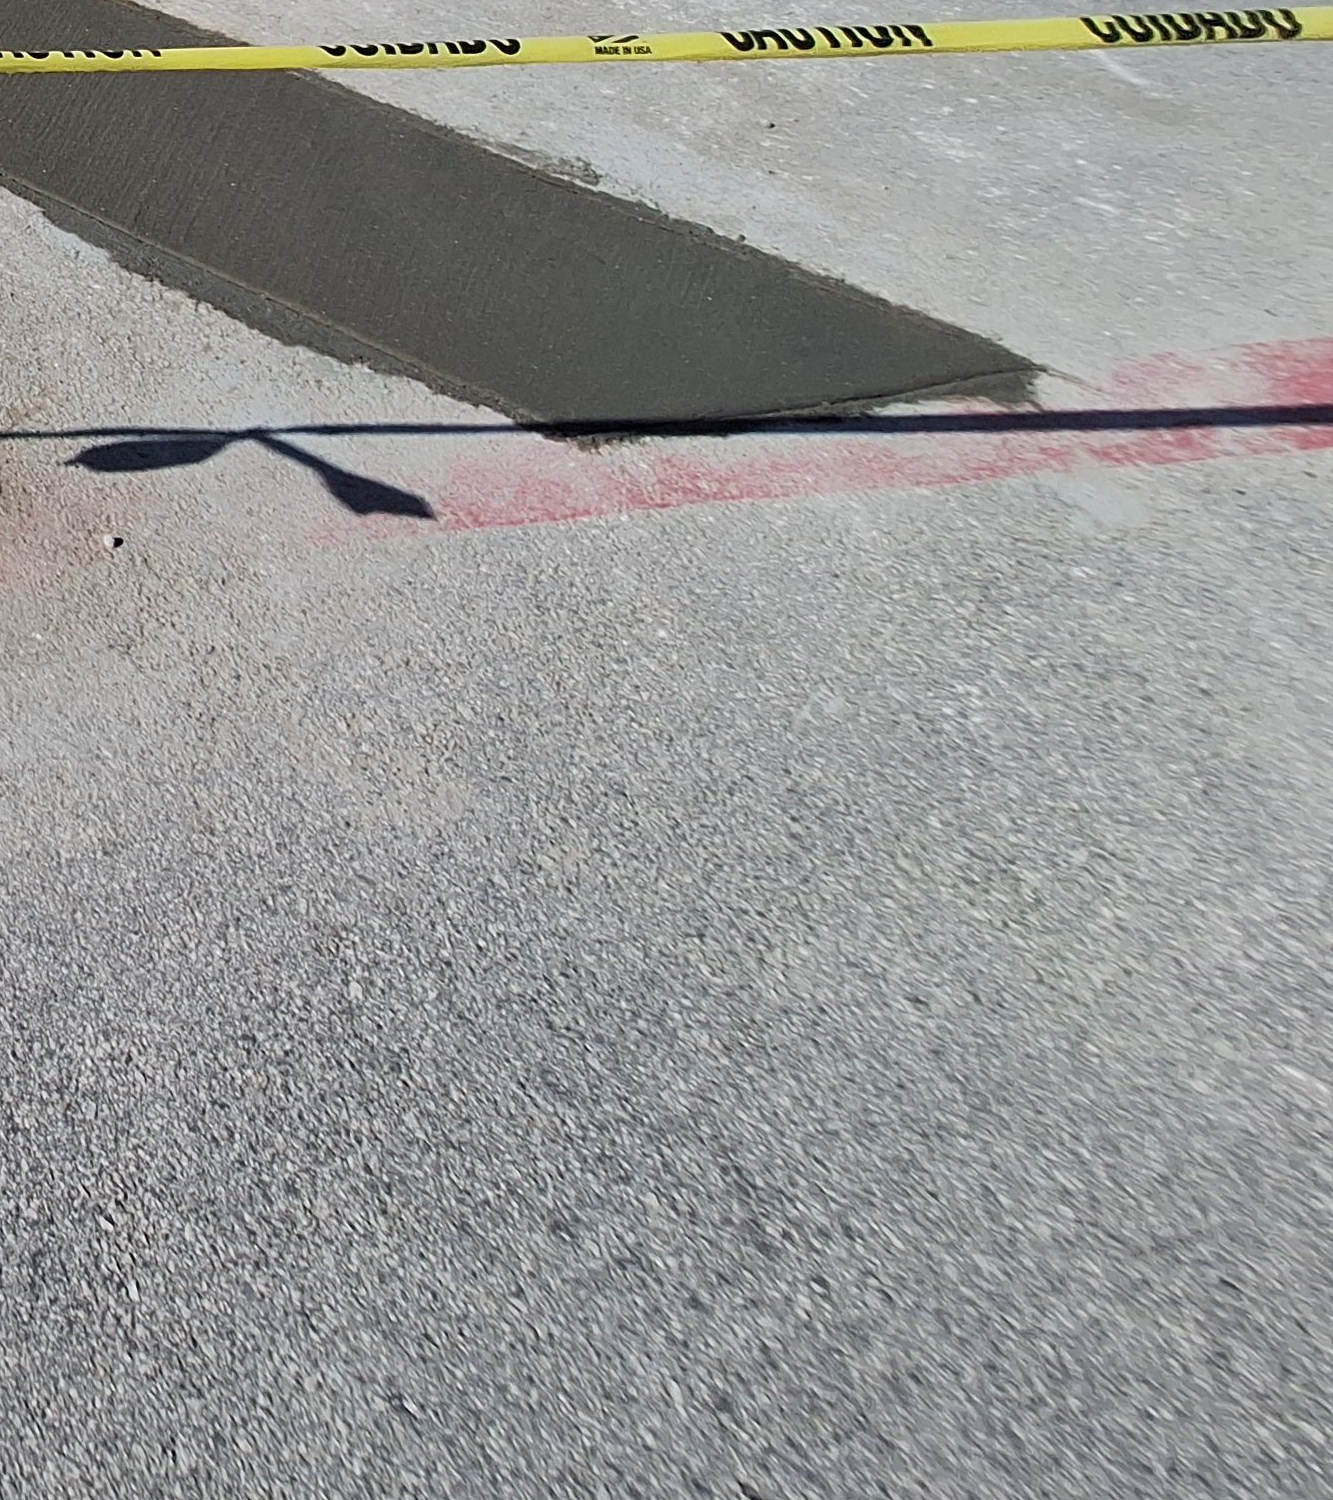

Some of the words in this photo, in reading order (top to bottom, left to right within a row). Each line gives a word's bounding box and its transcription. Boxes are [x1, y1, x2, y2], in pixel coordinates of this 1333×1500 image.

[594, 46, 620, 55] MADE
[622, 46, 632, 55] IN
[633, 46, 652, 55] USA
